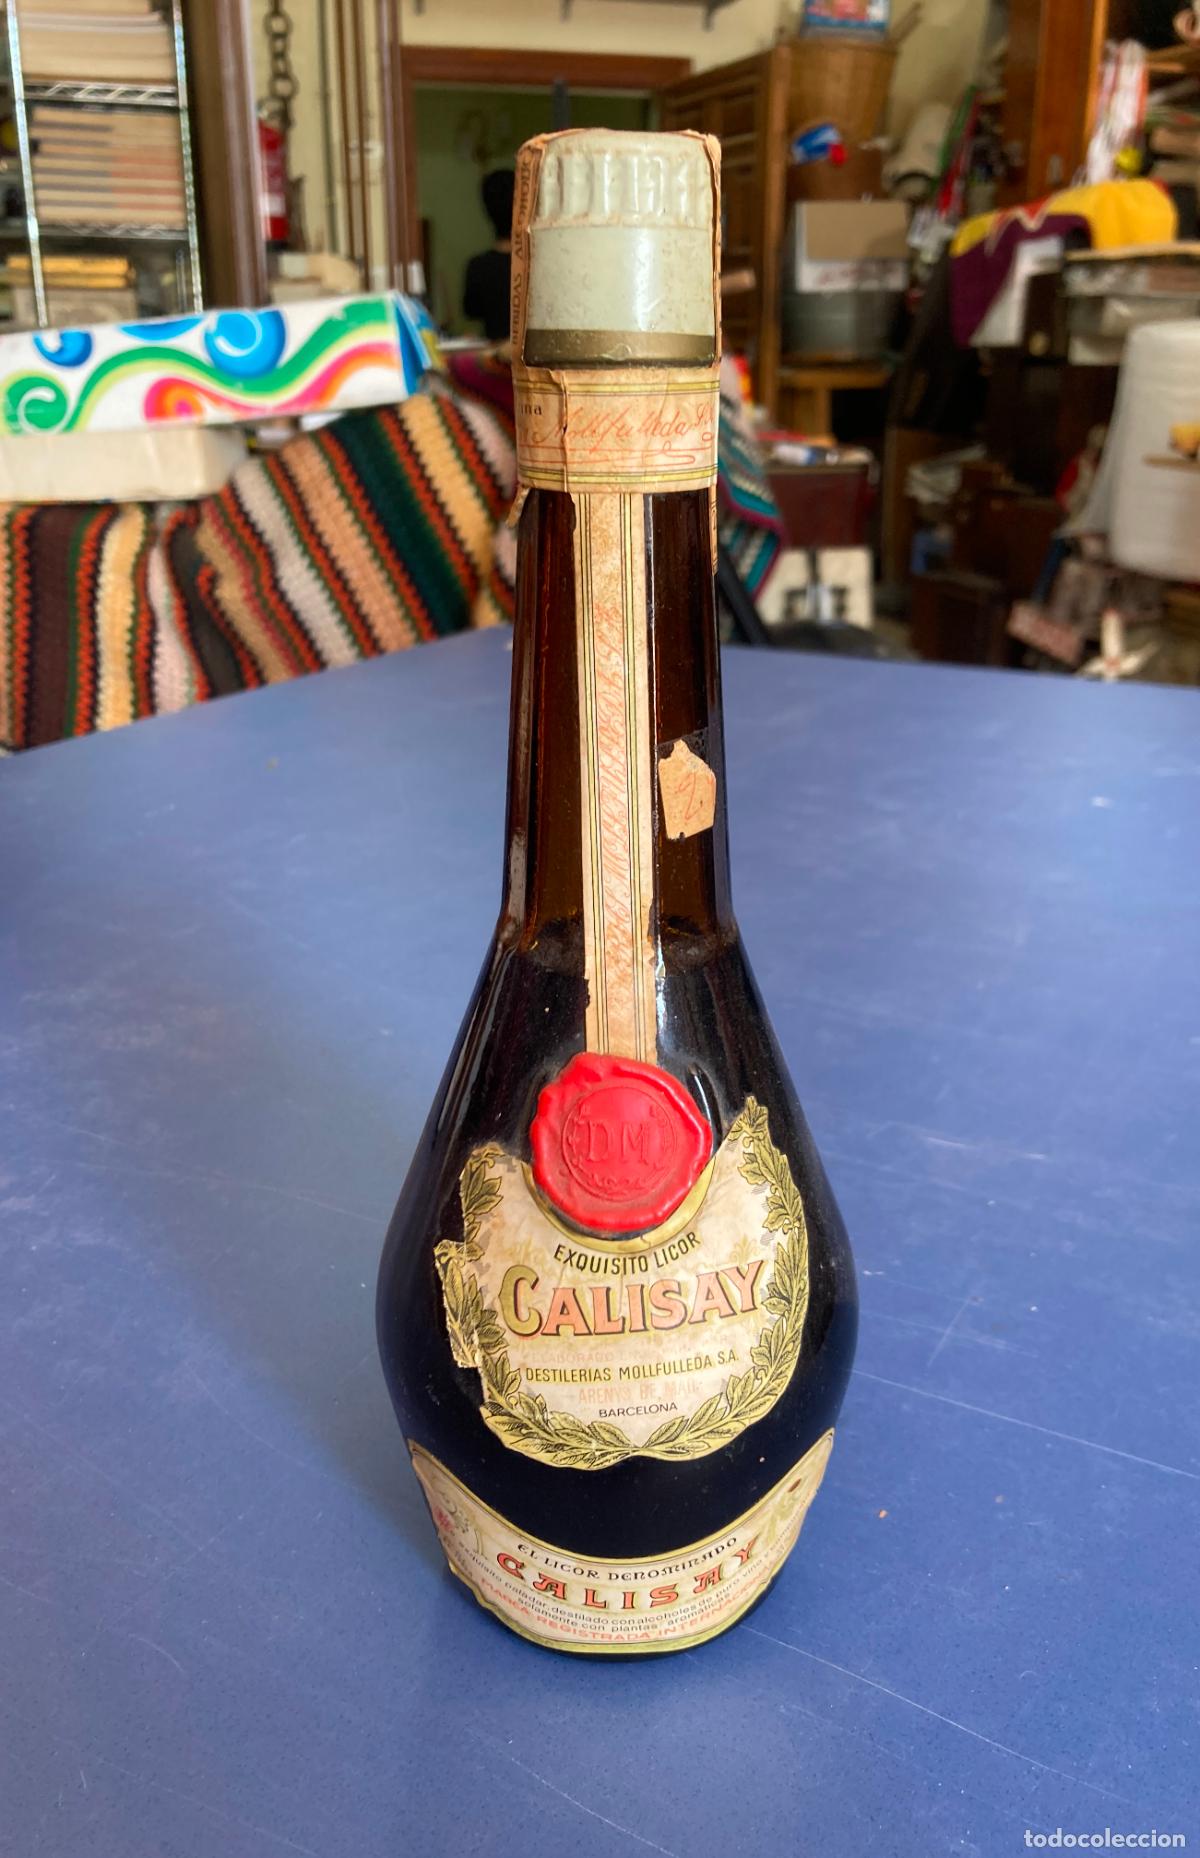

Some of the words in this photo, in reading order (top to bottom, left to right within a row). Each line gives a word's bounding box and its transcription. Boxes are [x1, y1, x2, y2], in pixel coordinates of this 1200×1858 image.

[553, 1244, 649, 1276] EXQUISITO
[655, 1231, 702, 1269] LICOR
[498, 1260, 766, 1338] CALISAY
[525, 1367, 613, 1384] DESTILERIAS
[619, 1355, 713, 1381] MOLLFULLEDA
[717, 1349, 741, 1366] S.A.
[599, 1401, 679, 1419] BARCELONA
[496, 1533, 762, 1610] CALISAY
[545, 1556, 601, 1580] LICOR
